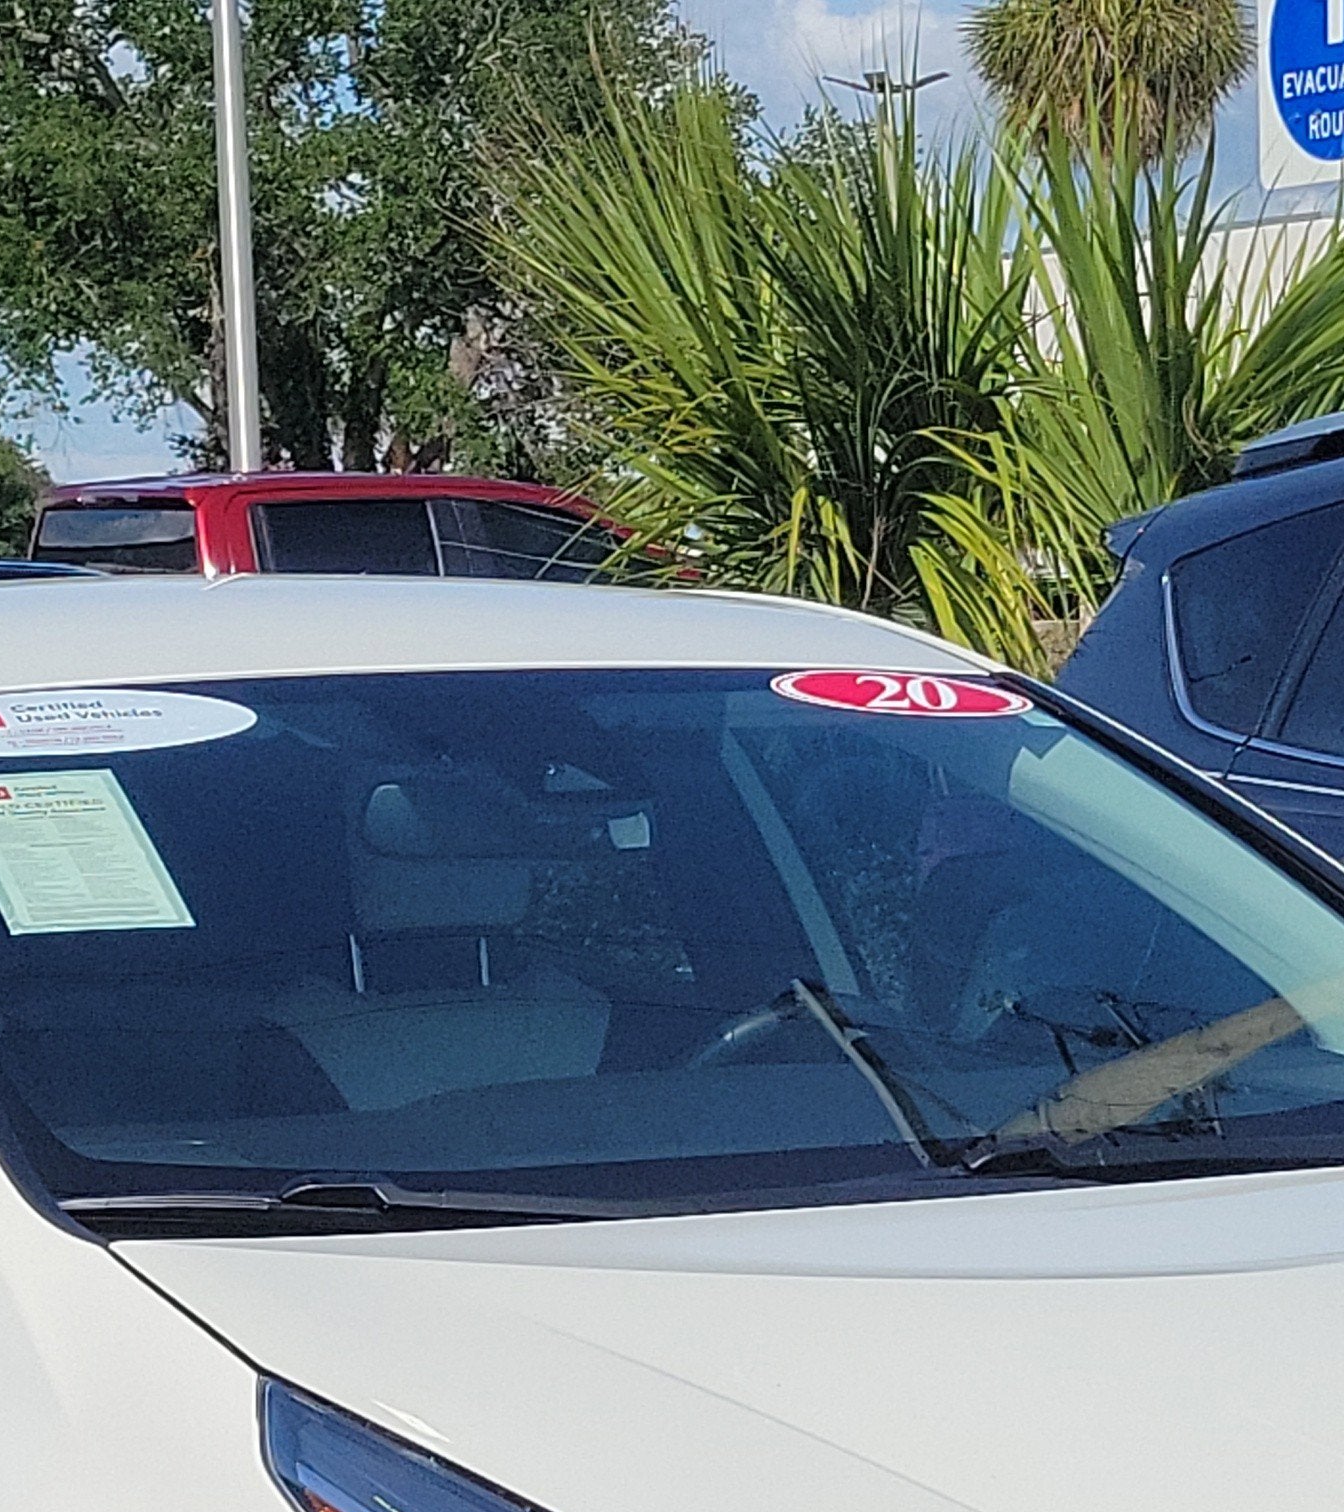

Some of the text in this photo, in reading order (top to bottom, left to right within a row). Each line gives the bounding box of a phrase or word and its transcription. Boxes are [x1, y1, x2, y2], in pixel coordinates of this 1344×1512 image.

[855, 674, 958, 711] 20
[9, 700, 104, 714] Certified
[15, 708, 163, 723] Used Vehicles
